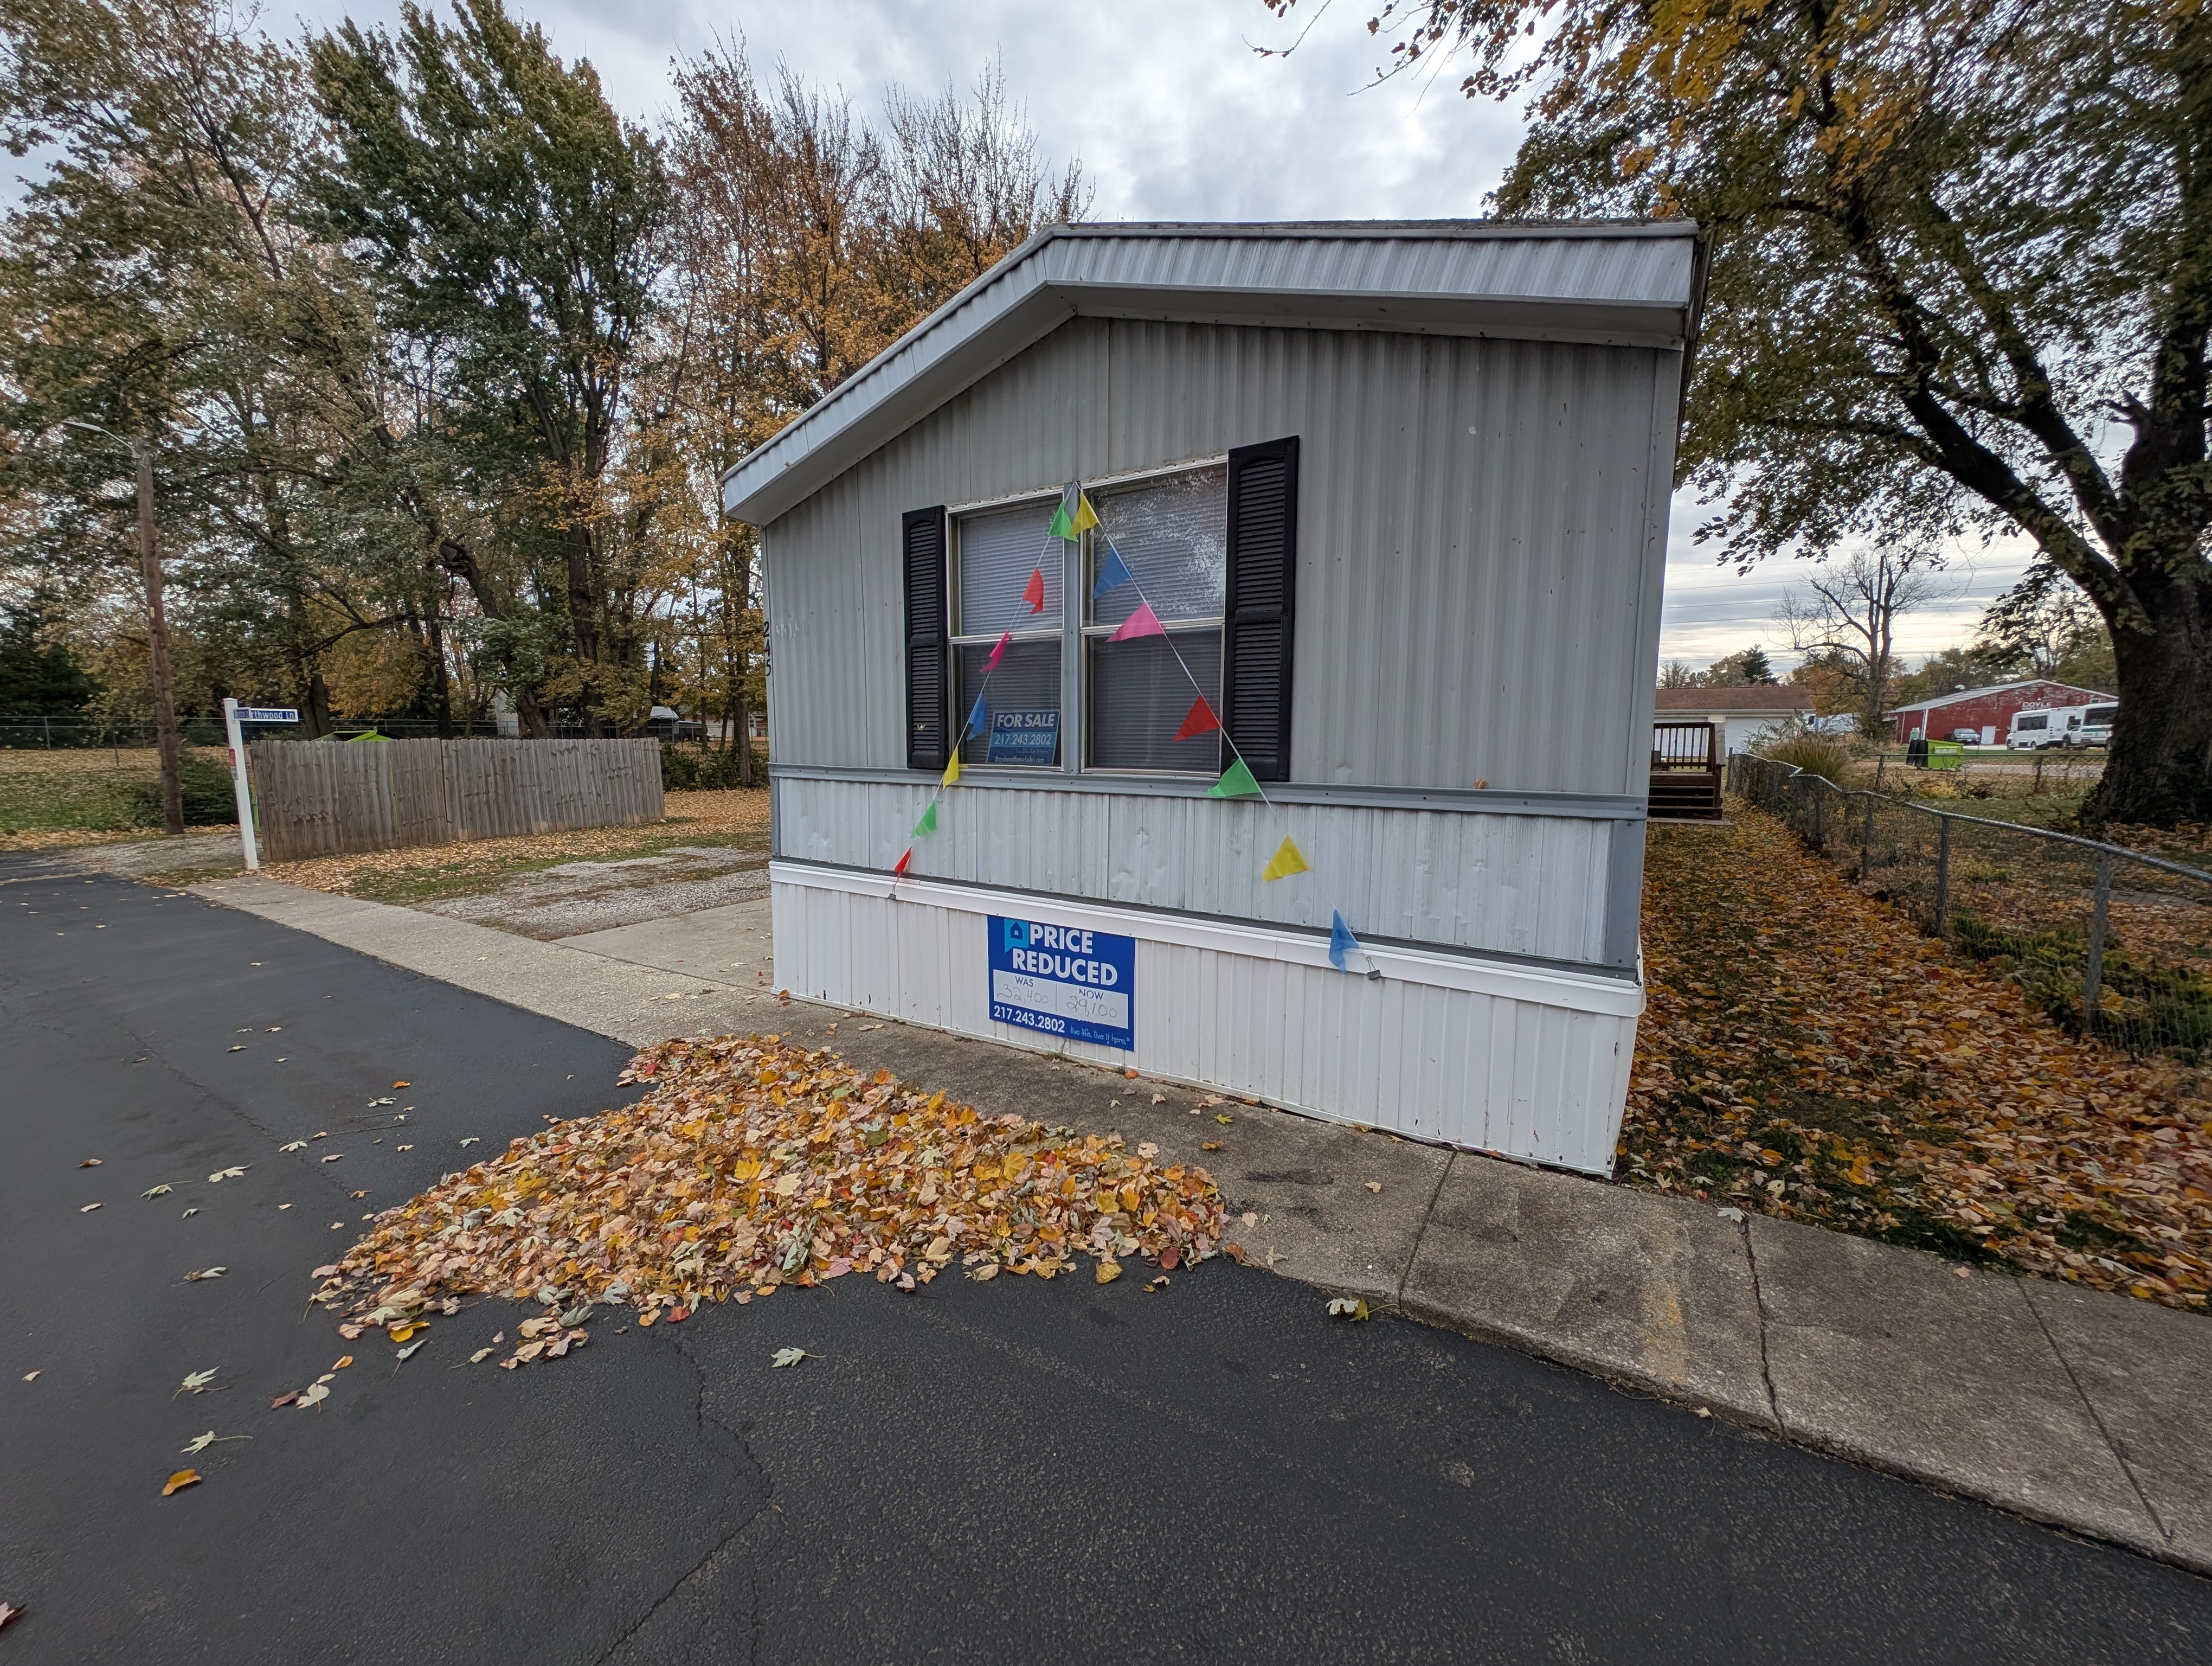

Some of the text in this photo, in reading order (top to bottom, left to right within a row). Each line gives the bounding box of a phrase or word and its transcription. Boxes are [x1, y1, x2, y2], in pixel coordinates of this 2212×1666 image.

[763, 621, 771, 677] 245
[250, 710, 283, 720] rthwood
[286, 711, 295, 720] Ln
[997, 713, 1055, 728] FOR SALE
[994, 733, 1052, 745] 217.243.2802
[1030, 924, 1093, 954] PRICE
[1012, 948, 1118, 986] REDUCED
[1015, 976, 1034, 988] WAS
[997, 984, 1049, 1004] 32,400
[1079, 988, 1104, 1000] NOW
[1066, 995, 1117, 1018] 29,100
[994, 1005, 1065, 1034] 217.243.2802
[1070, 1026, 1080, 1036] live
[1094, 1030, 1104, 1040] live
